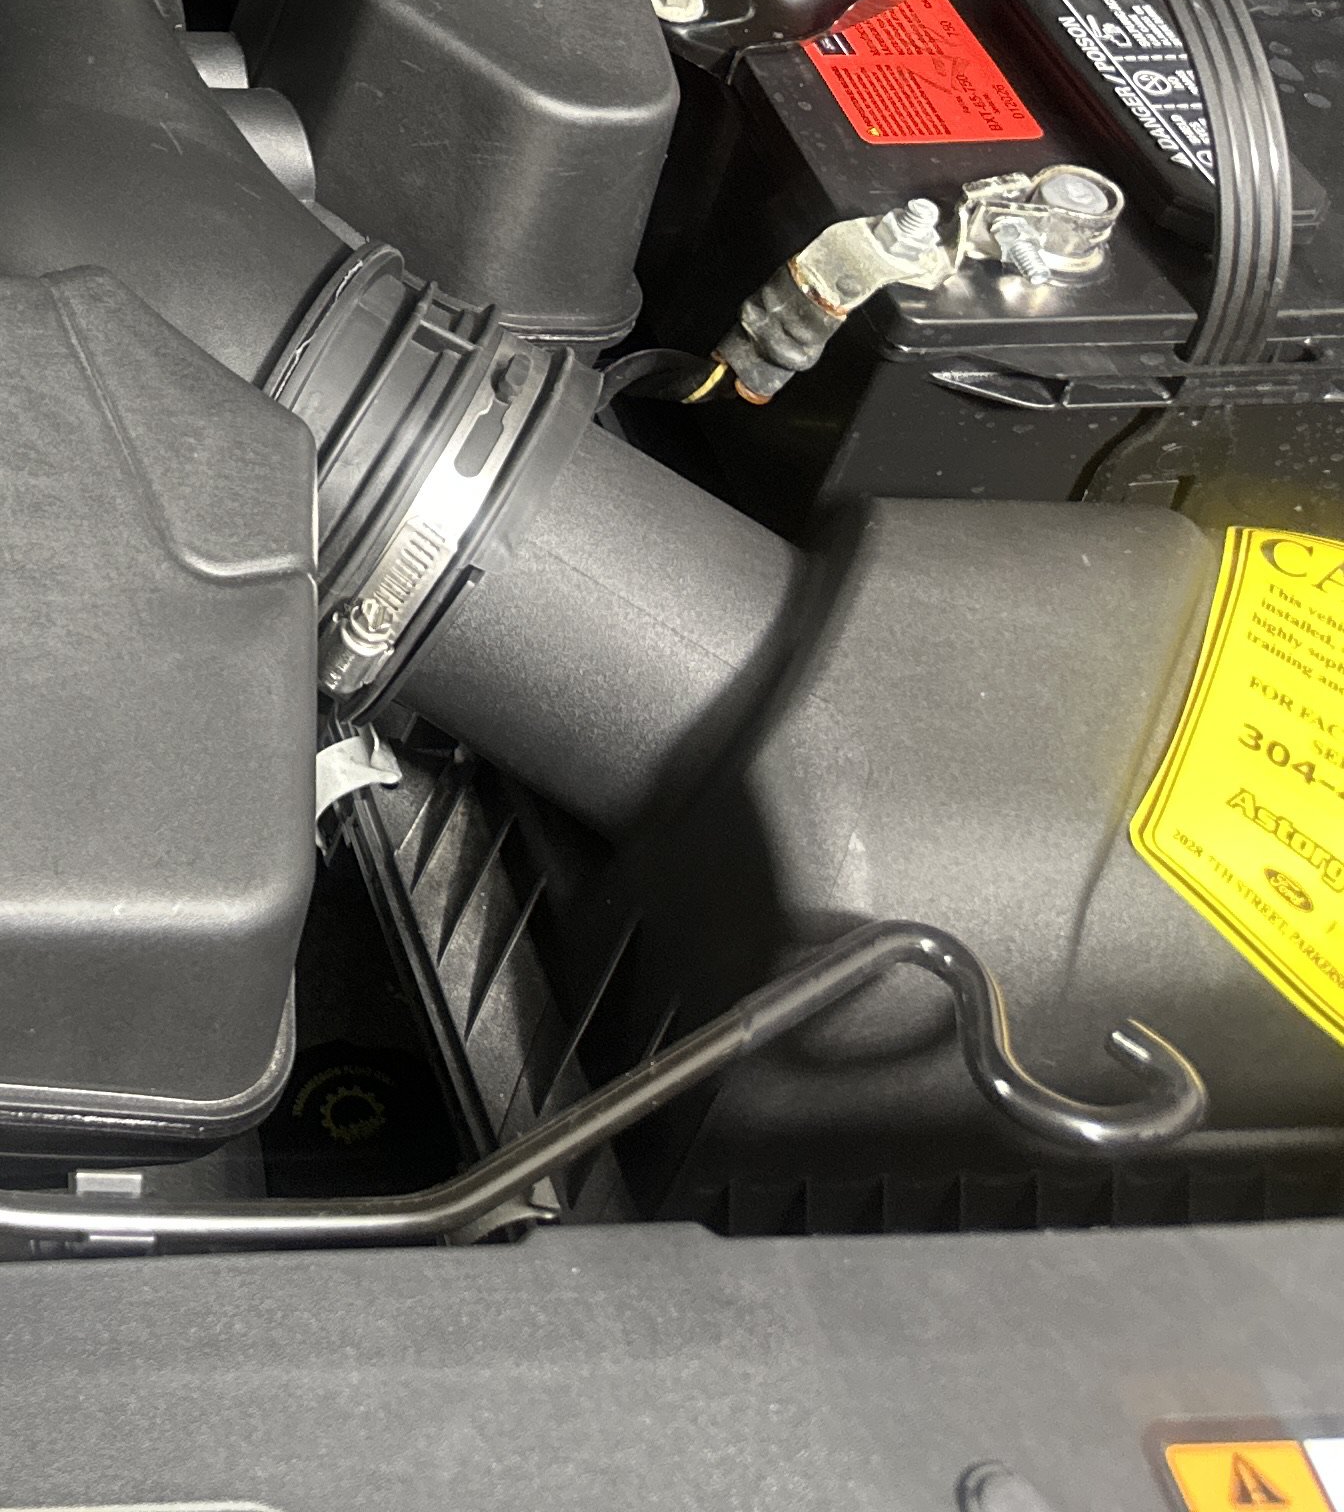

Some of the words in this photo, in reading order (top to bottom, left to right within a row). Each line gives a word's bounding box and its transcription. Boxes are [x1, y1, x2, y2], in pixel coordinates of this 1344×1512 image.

[1058, 15, 1116, 73] POISON
[1102, 73, 1126, 85] /
[1114, 86, 1179, 150] DANGER
[1269, 584, 1302, 608] This
[1252, 612, 1302, 649] highly
[1262, 599, 1335, 650] installed,
[1247, 631, 1312, 679] training
[1249, 676, 1294, 712] FOR
[1238, 723, 1344, 799] 304-
[1268, 871, 1312, 910] Ford
